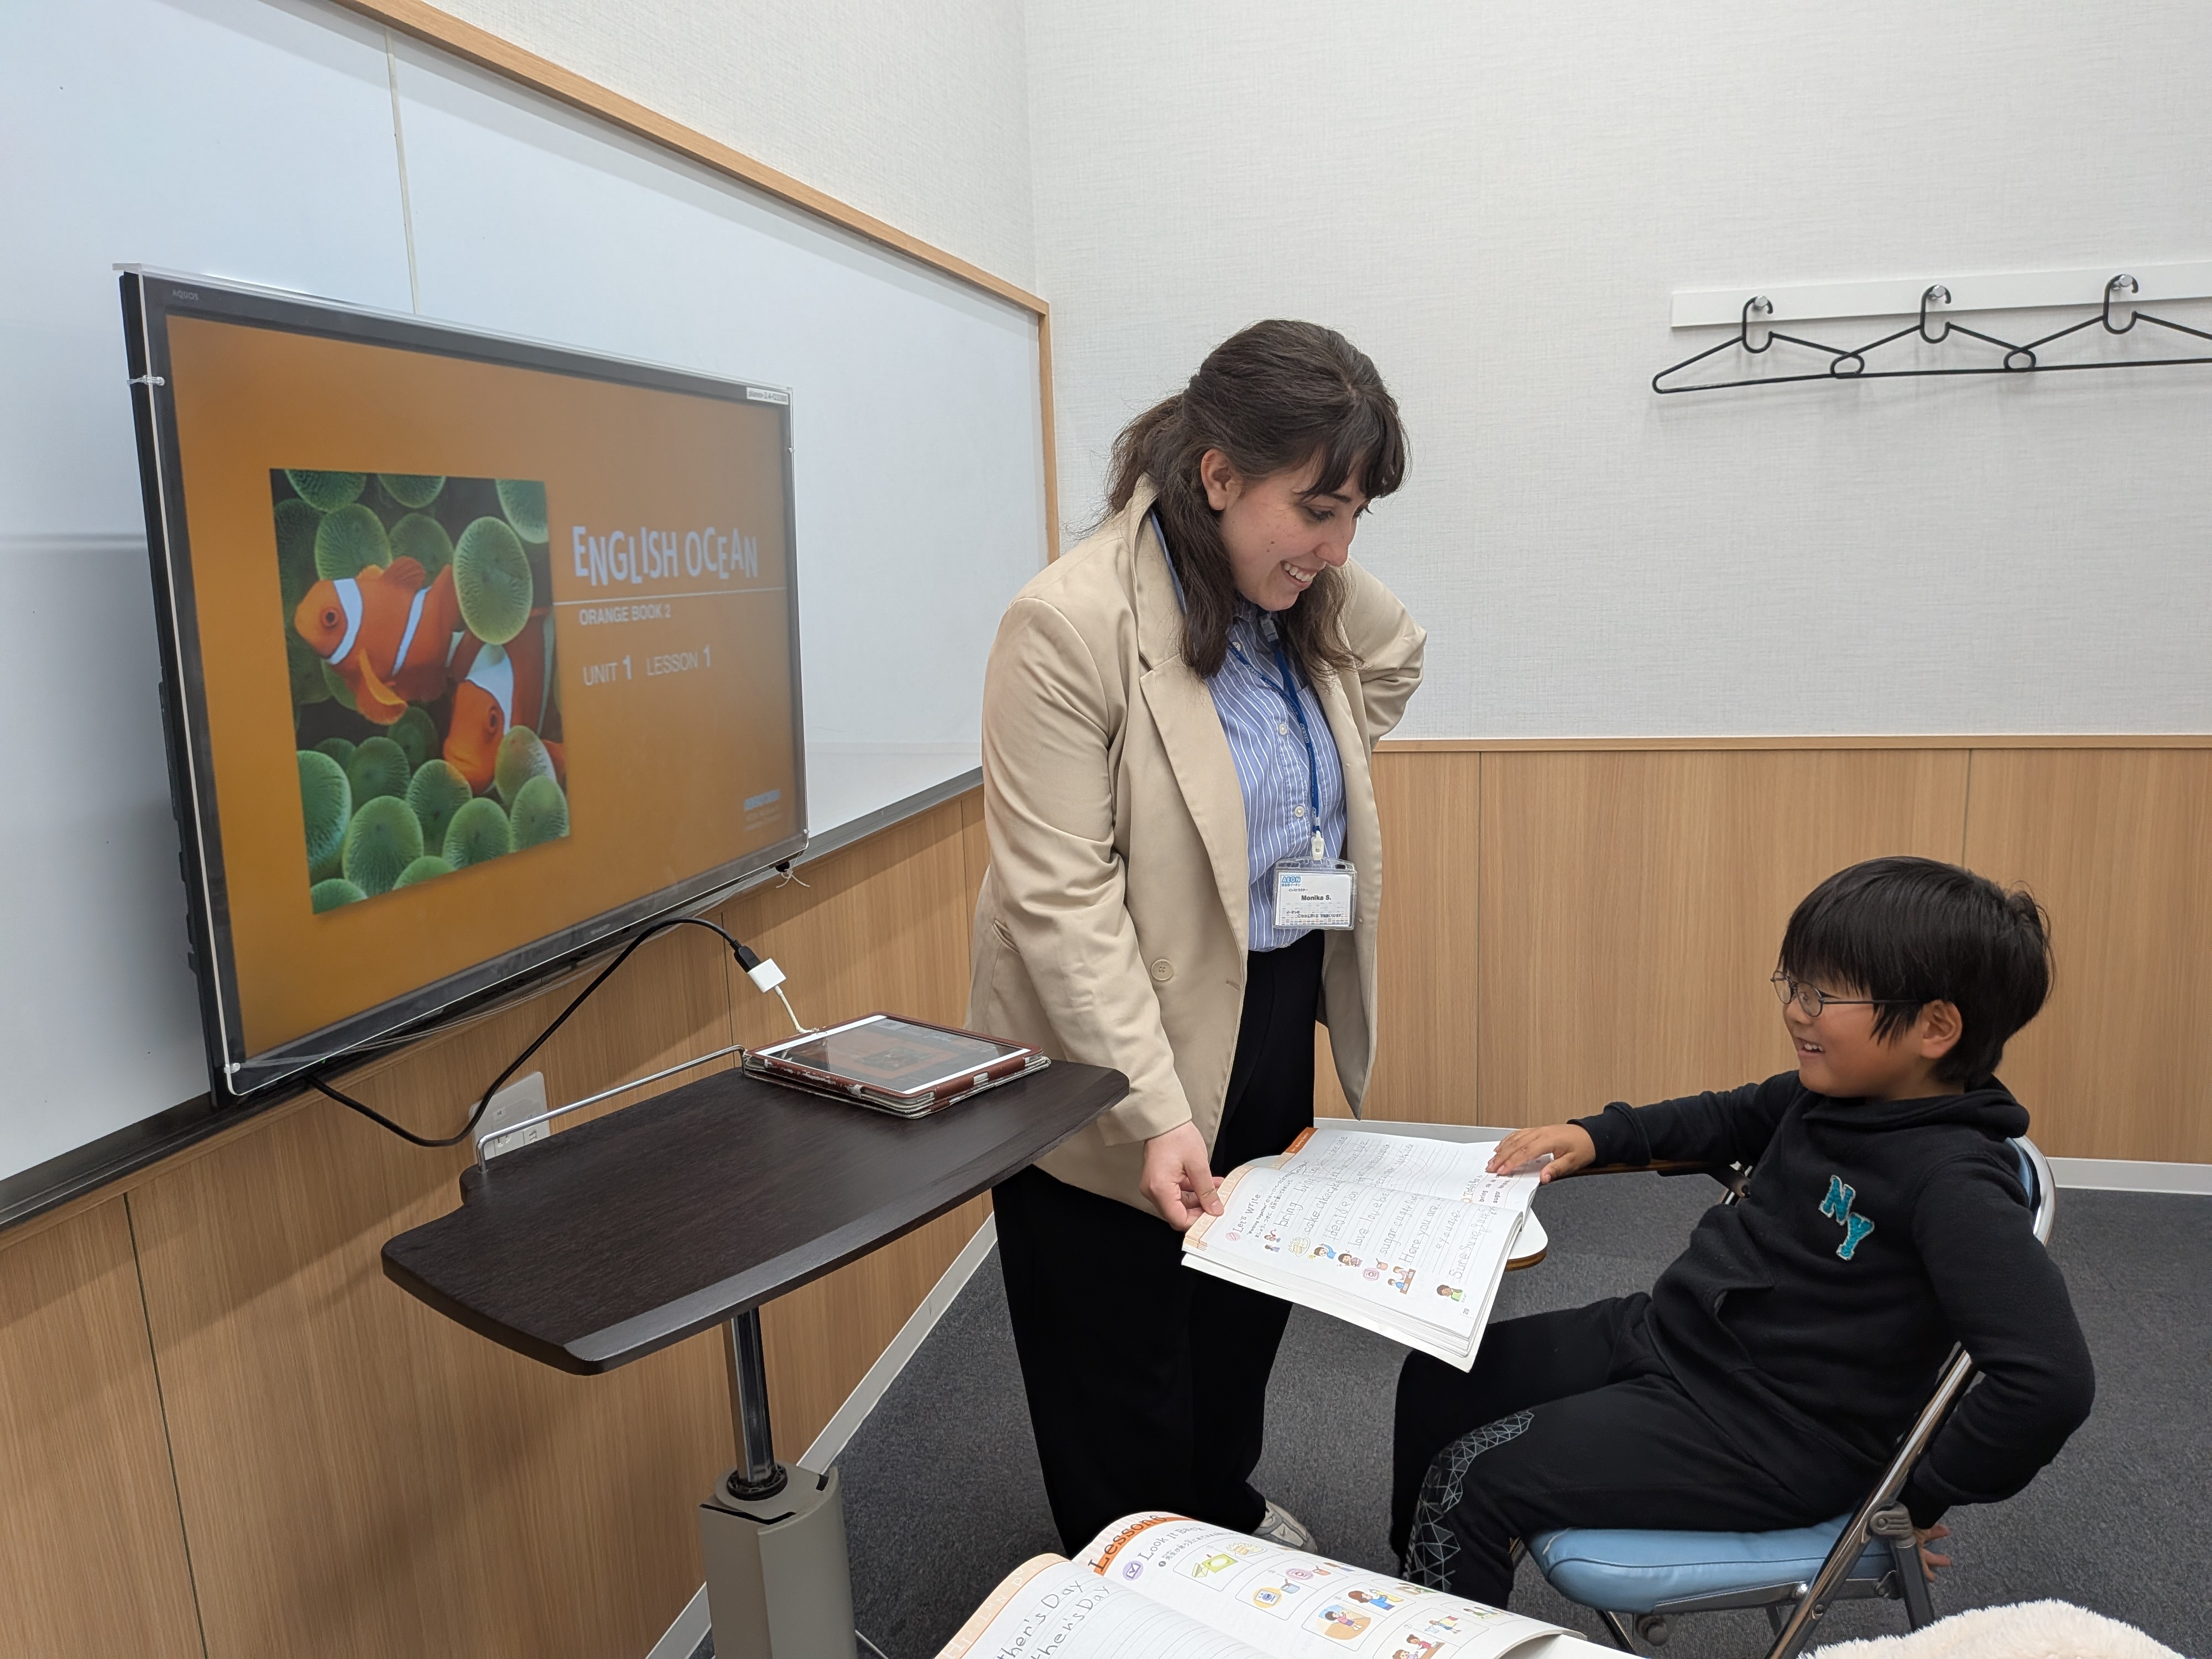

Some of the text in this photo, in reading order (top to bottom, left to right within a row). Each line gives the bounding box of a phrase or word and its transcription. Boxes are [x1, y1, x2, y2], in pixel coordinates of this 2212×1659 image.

[572, 526, 758, 586] ENGLISH OCEAN
[579, 604, 671, 625] ORANGE BOOK 2
[583, 645, 712, 685] UNIT 1 LESSON 1
[1479, 1190, 1489, 1202] bring
[1233, 1194, 1261, 1233] Let's Write
[1273, 1202, 1304, 1228] bring
[1303, 1211, 1321, 1233] cake
[1818, 1175, 1875, 1260] NY
[1348, 1228, 1370, 1246] love
[1380, 1227, 1402, 1255] sugar
[1399, 1239, 1422, 1263] Here
[1418, 1219, 1431, 1238] you
[1449, 1252, 1471, 1279] Sure
[1088, 1517, 1161, 1572] Lesson
[1138, 1538, 1169, 1561] Look
[1040, 1580, 1083, 1609] Day
[1076, 1585, 1110, 1610] Day
